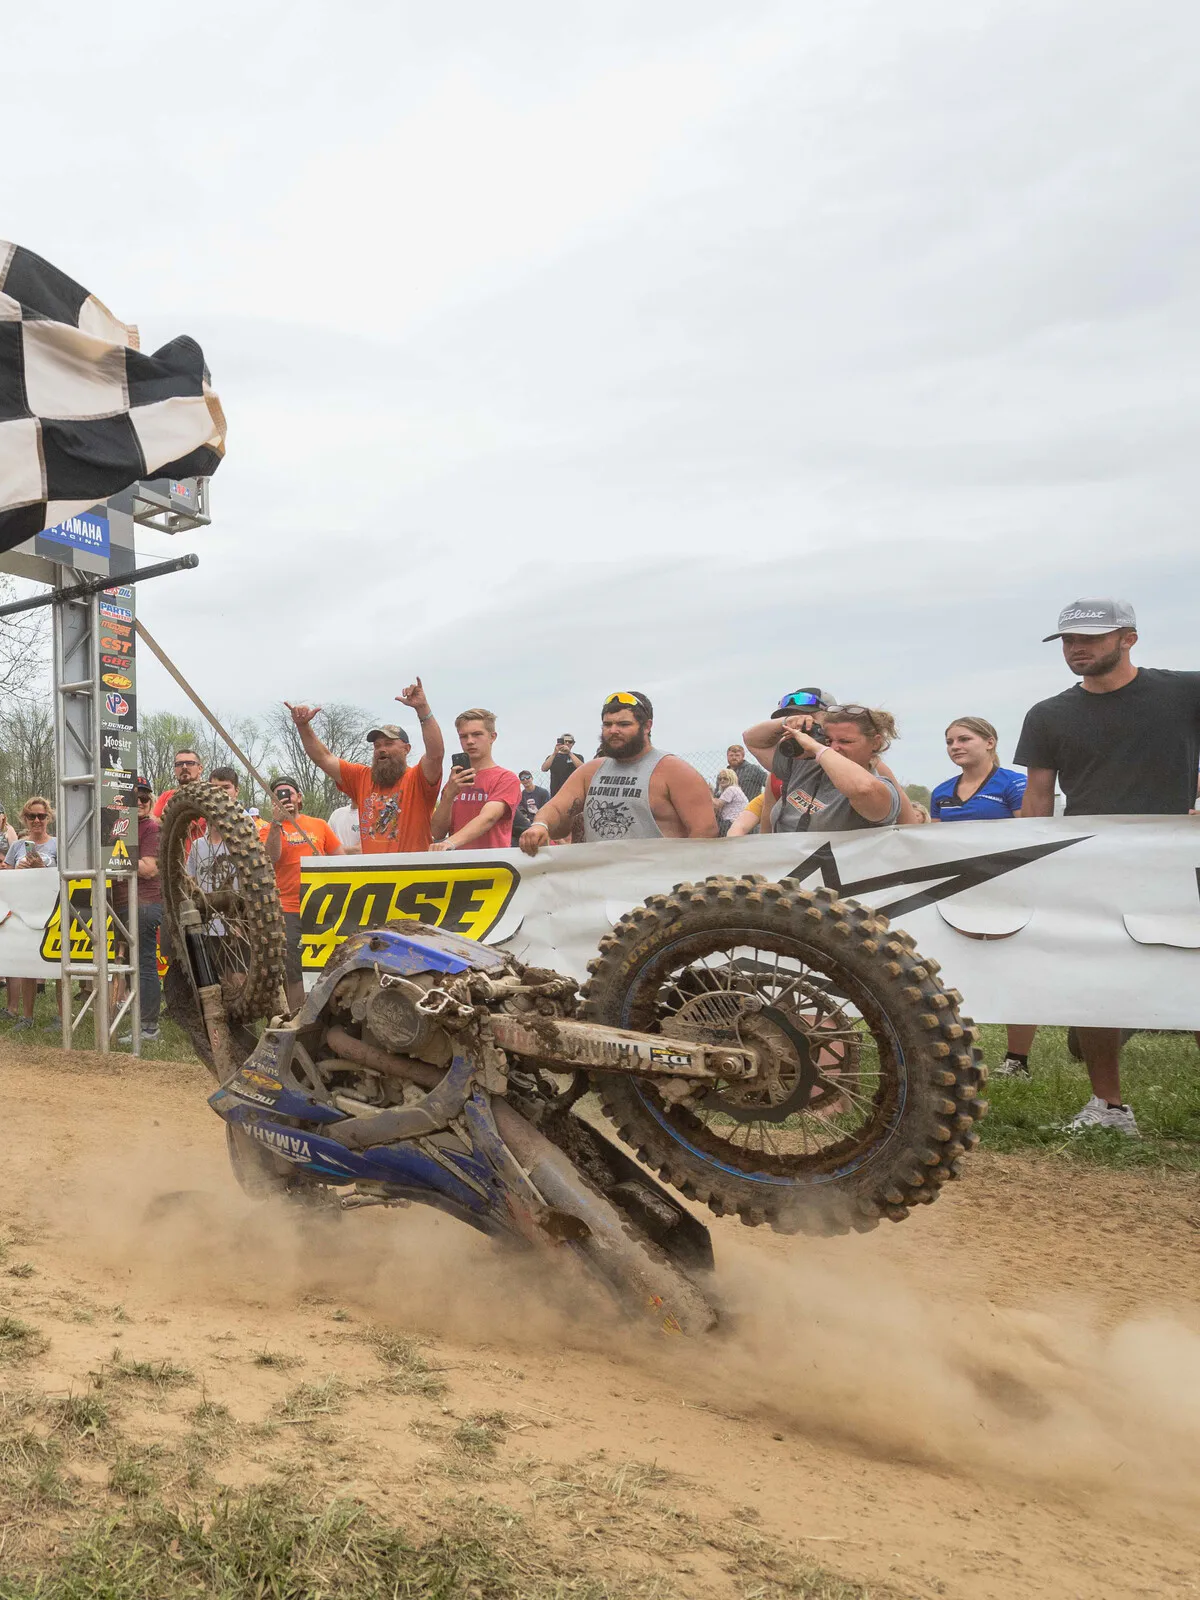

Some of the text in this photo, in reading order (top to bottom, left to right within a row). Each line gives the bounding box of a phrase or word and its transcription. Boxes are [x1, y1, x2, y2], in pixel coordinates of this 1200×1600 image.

[100, 602, 132, 617] PARTS
[101, 636, 132, 654] CST
[102, 654, 132, 669] GBC
[108, 721, 134, 731] DUNLOP
[104, 735, 132, 749] Hoosier
[104, 770, 132, 779] MICHELIN
[599, 775, 638, 786] TRIMBLE
[588, 786, 642, 798] ALUMNI WAR
[108, 858, 132, 867] ARMA
[301, 878, 495, 937] OOSE
[241, 1121, 312, 1157] YAMAHA
